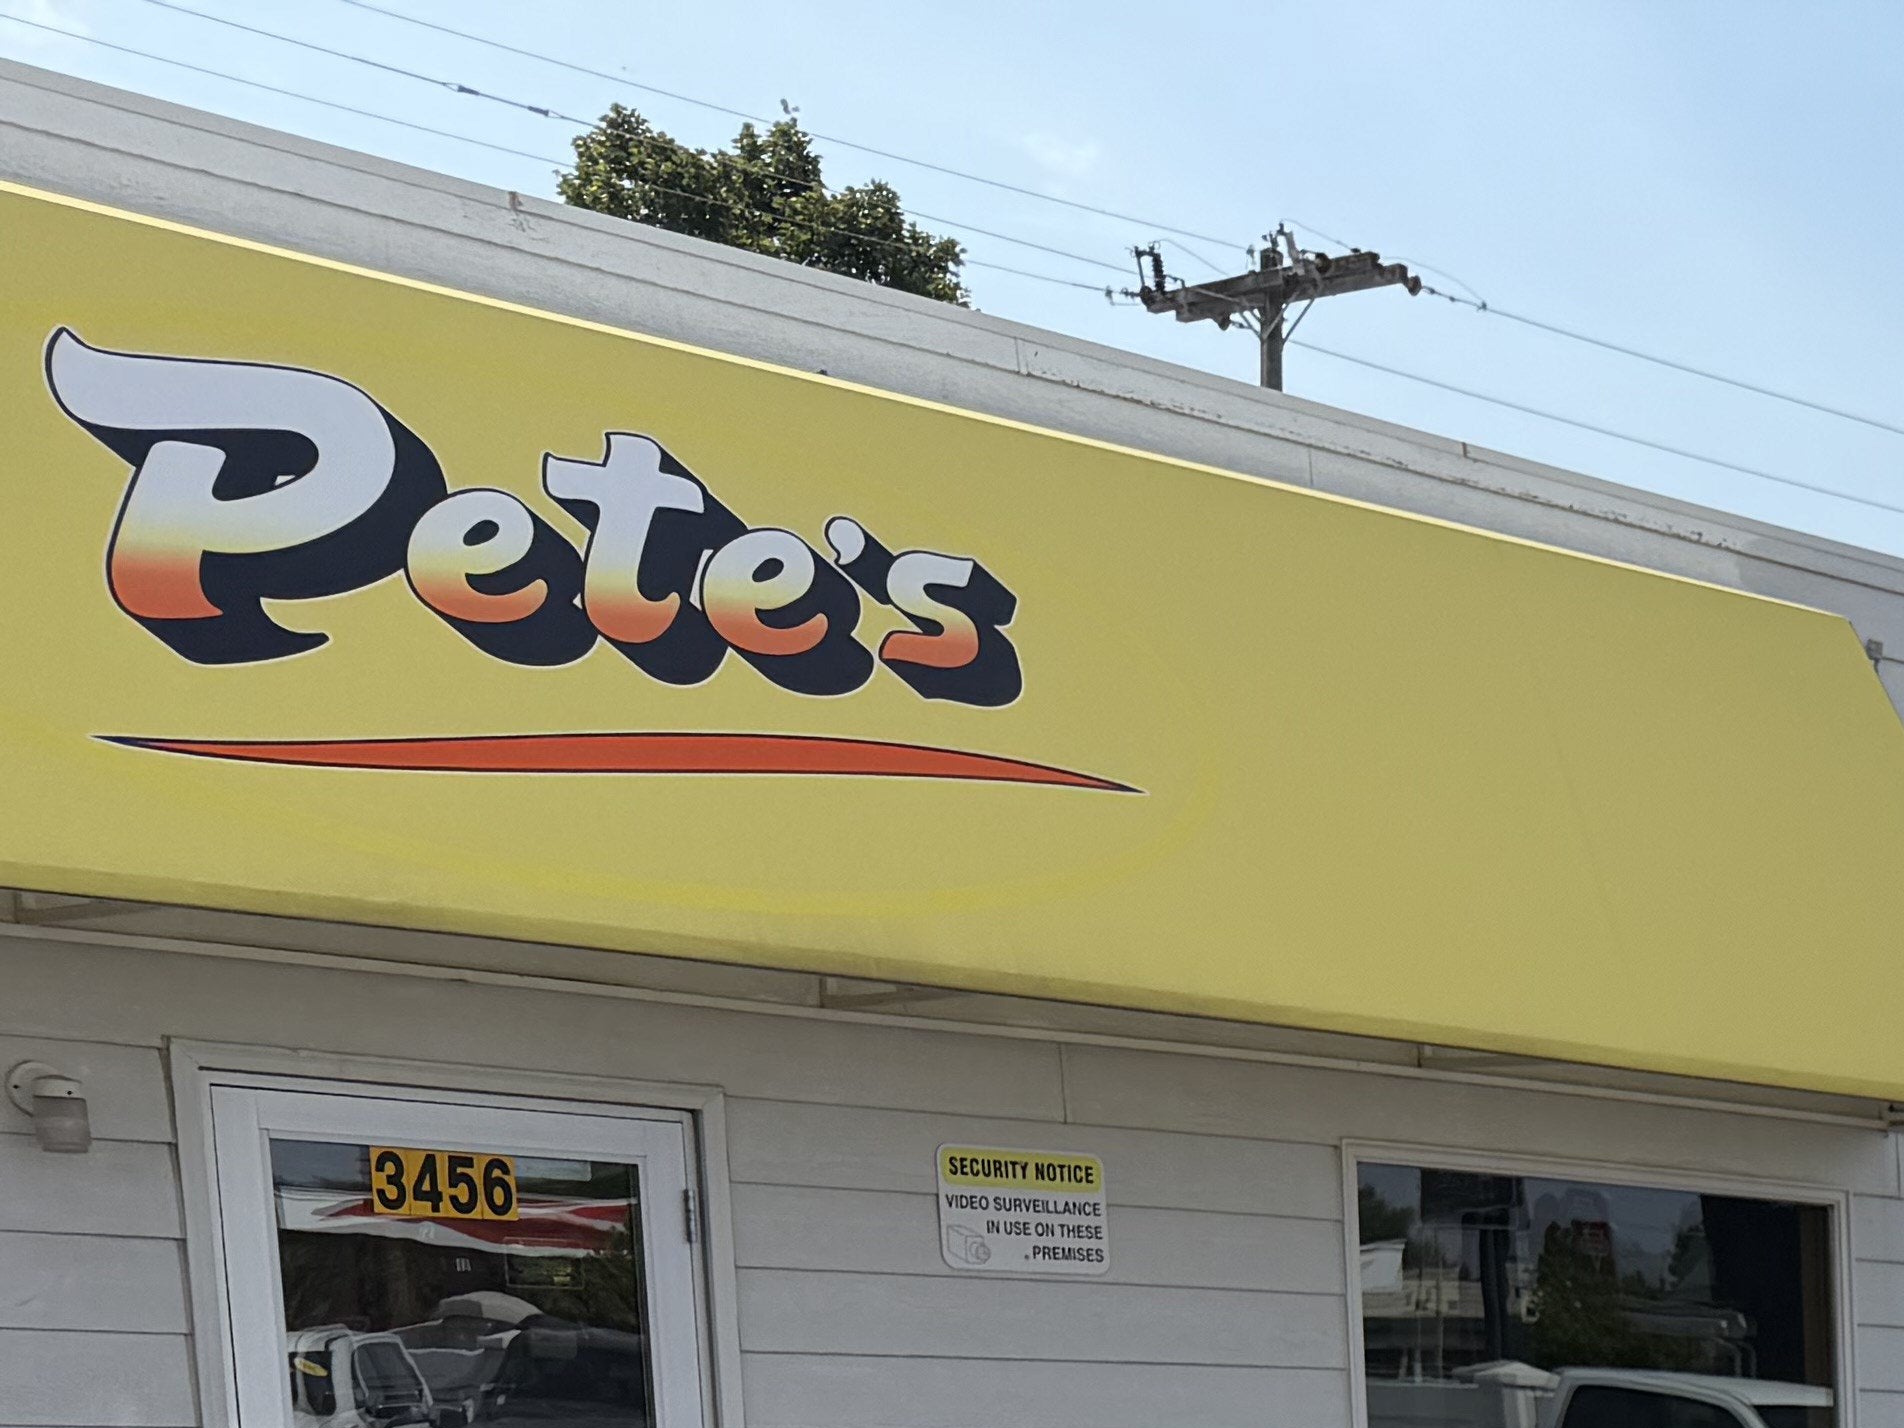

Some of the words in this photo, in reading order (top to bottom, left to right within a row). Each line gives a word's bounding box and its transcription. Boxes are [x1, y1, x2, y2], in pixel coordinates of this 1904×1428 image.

[43, 325, 1023, 704] Pete's
[948, 1156, 1029, 1180] SECURITY
[1035, 1162, 1094, 1184] NOTICE
[374, 1150, 514, 1217] 3456
[945, 1194, 989, 1211] VIDEO
[993, 1196, 1102, 1217] SURVEILLANCE
[986, 1220, 1000, 1234] IN
[1003, 1221, 1031, 1236] USE
[1034, 1221, 1055, 1238] ON
[1057, 1223, 1104, 1240] THESE
[1032, 1245, 1105, 1263] PREMISES
